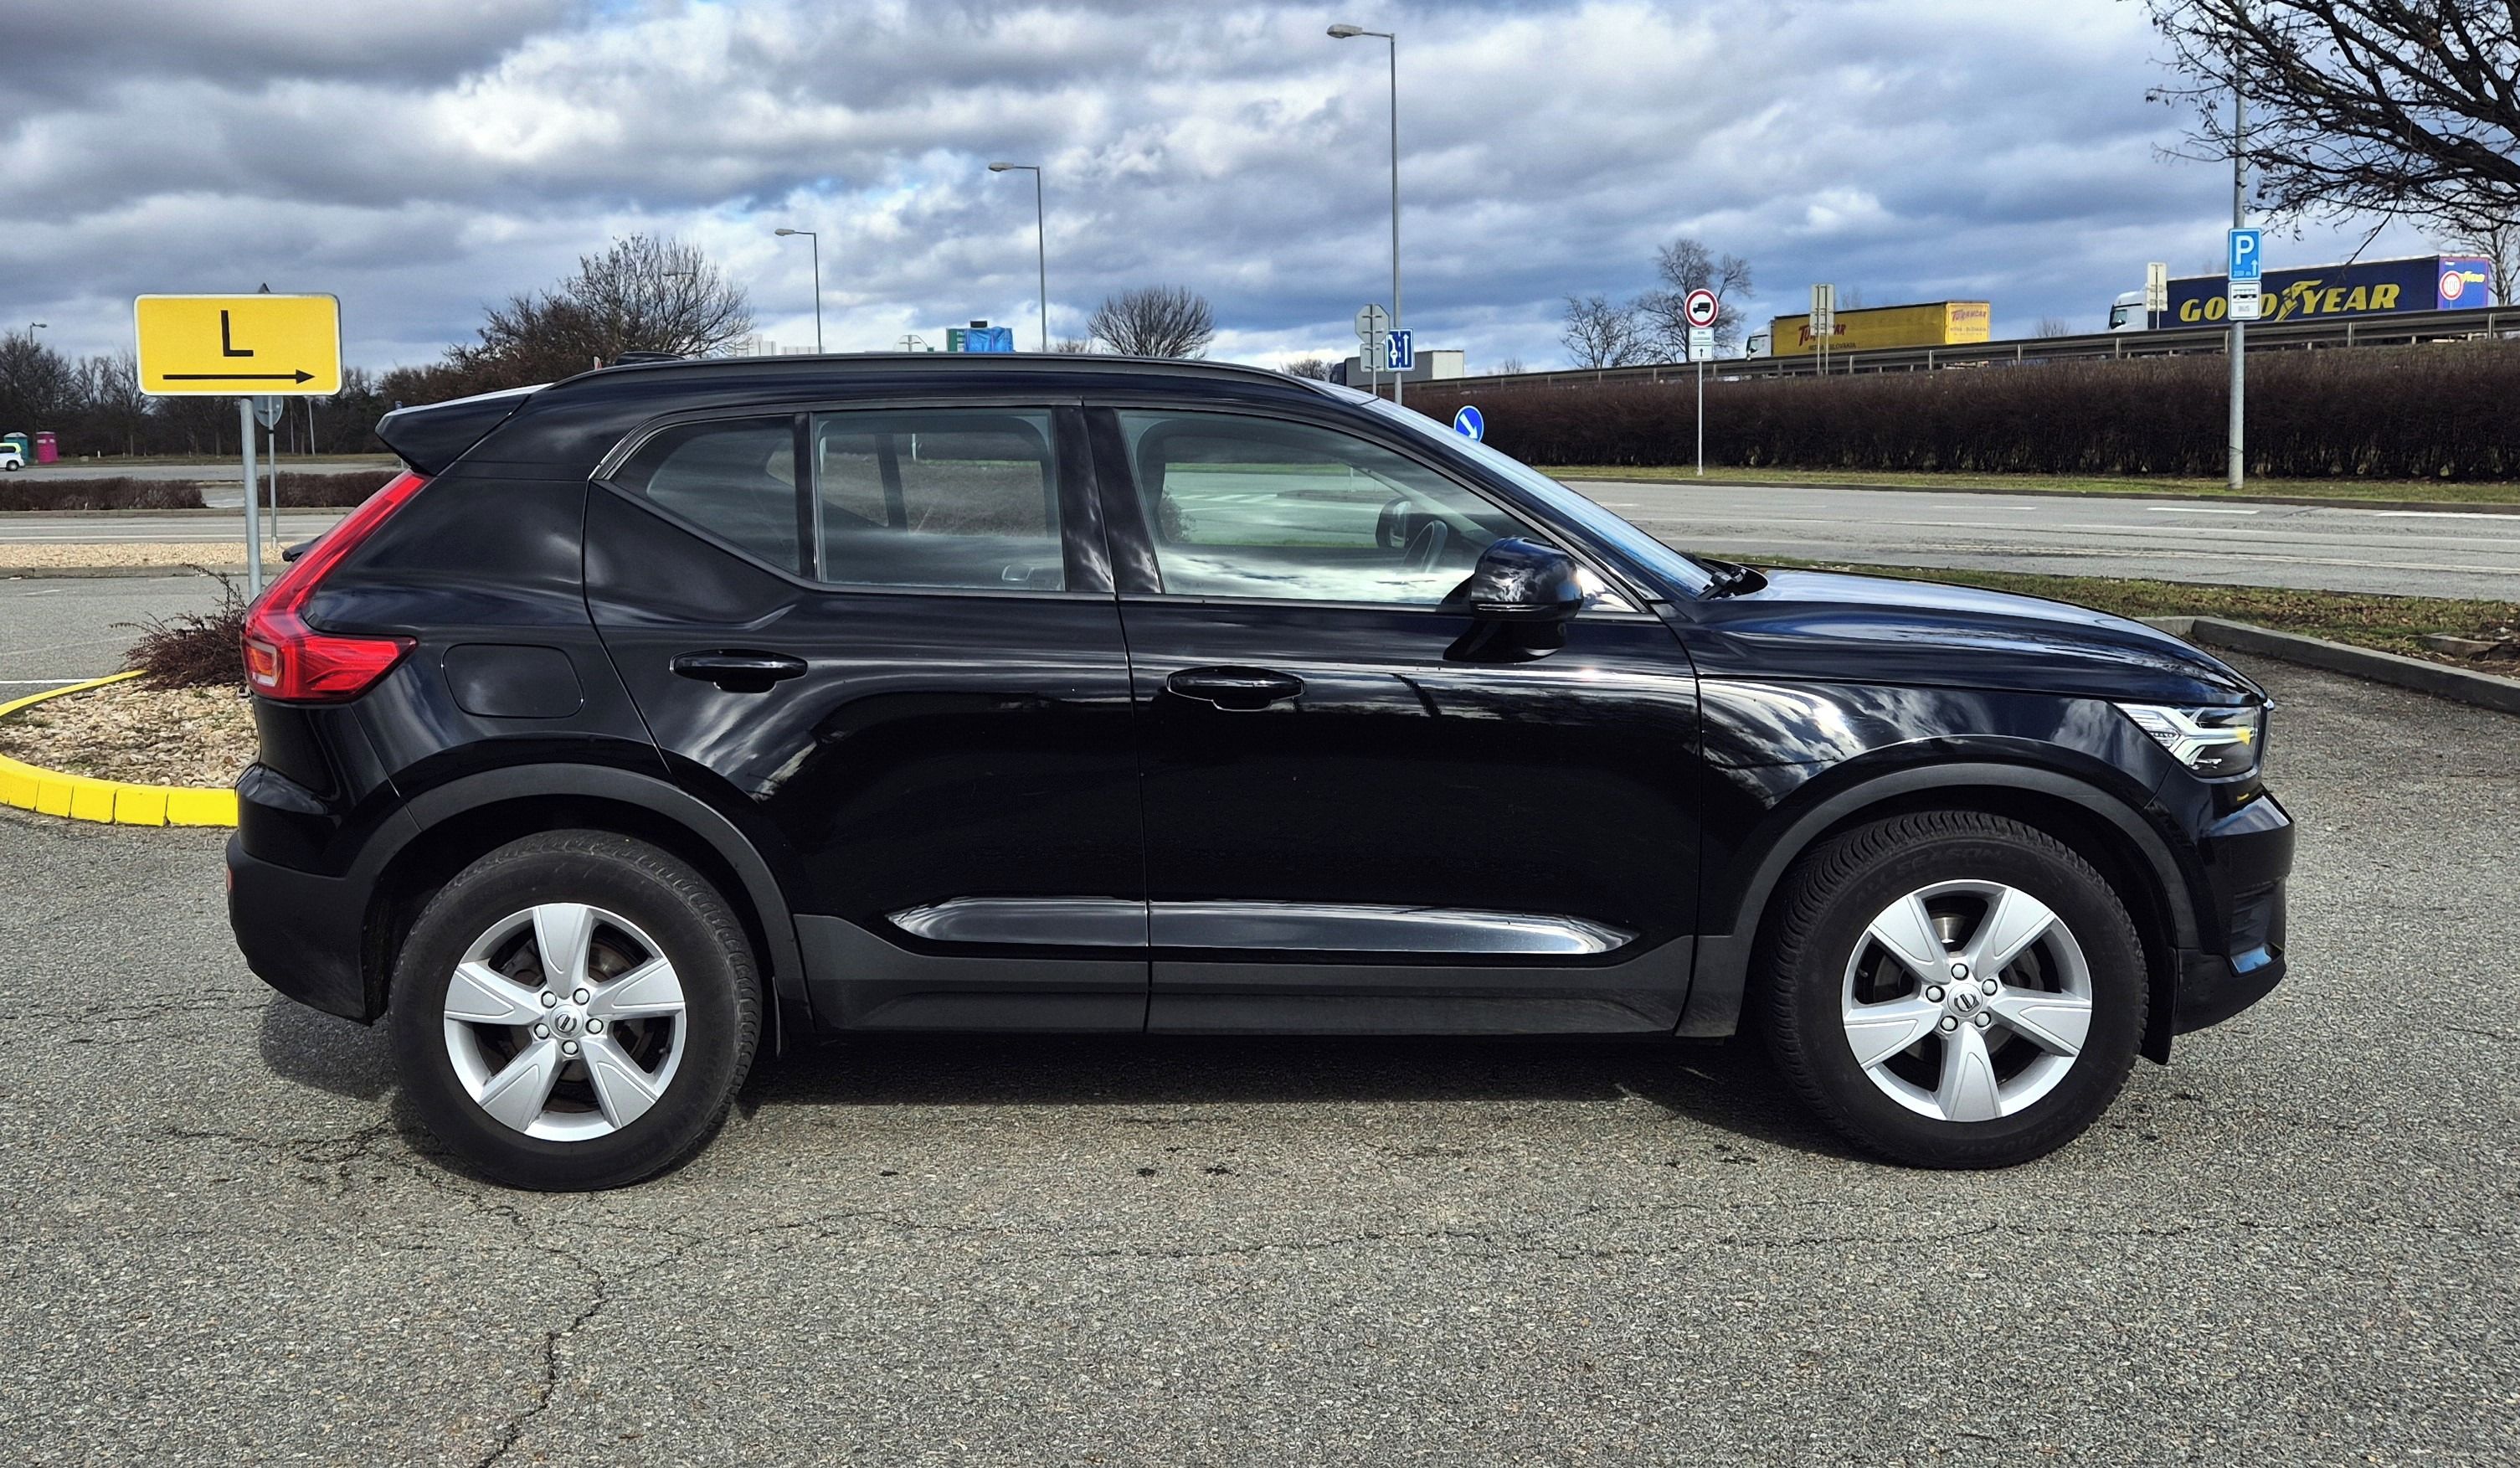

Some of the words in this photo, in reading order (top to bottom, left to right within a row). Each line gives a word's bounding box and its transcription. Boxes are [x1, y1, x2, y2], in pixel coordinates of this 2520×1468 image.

[2235, 234, 2255, 265] P
[2179, 283, 2400, 322] GODYEAR
[2445, 280, 2458, 292] 100
[220, 310, 254, 357] L
